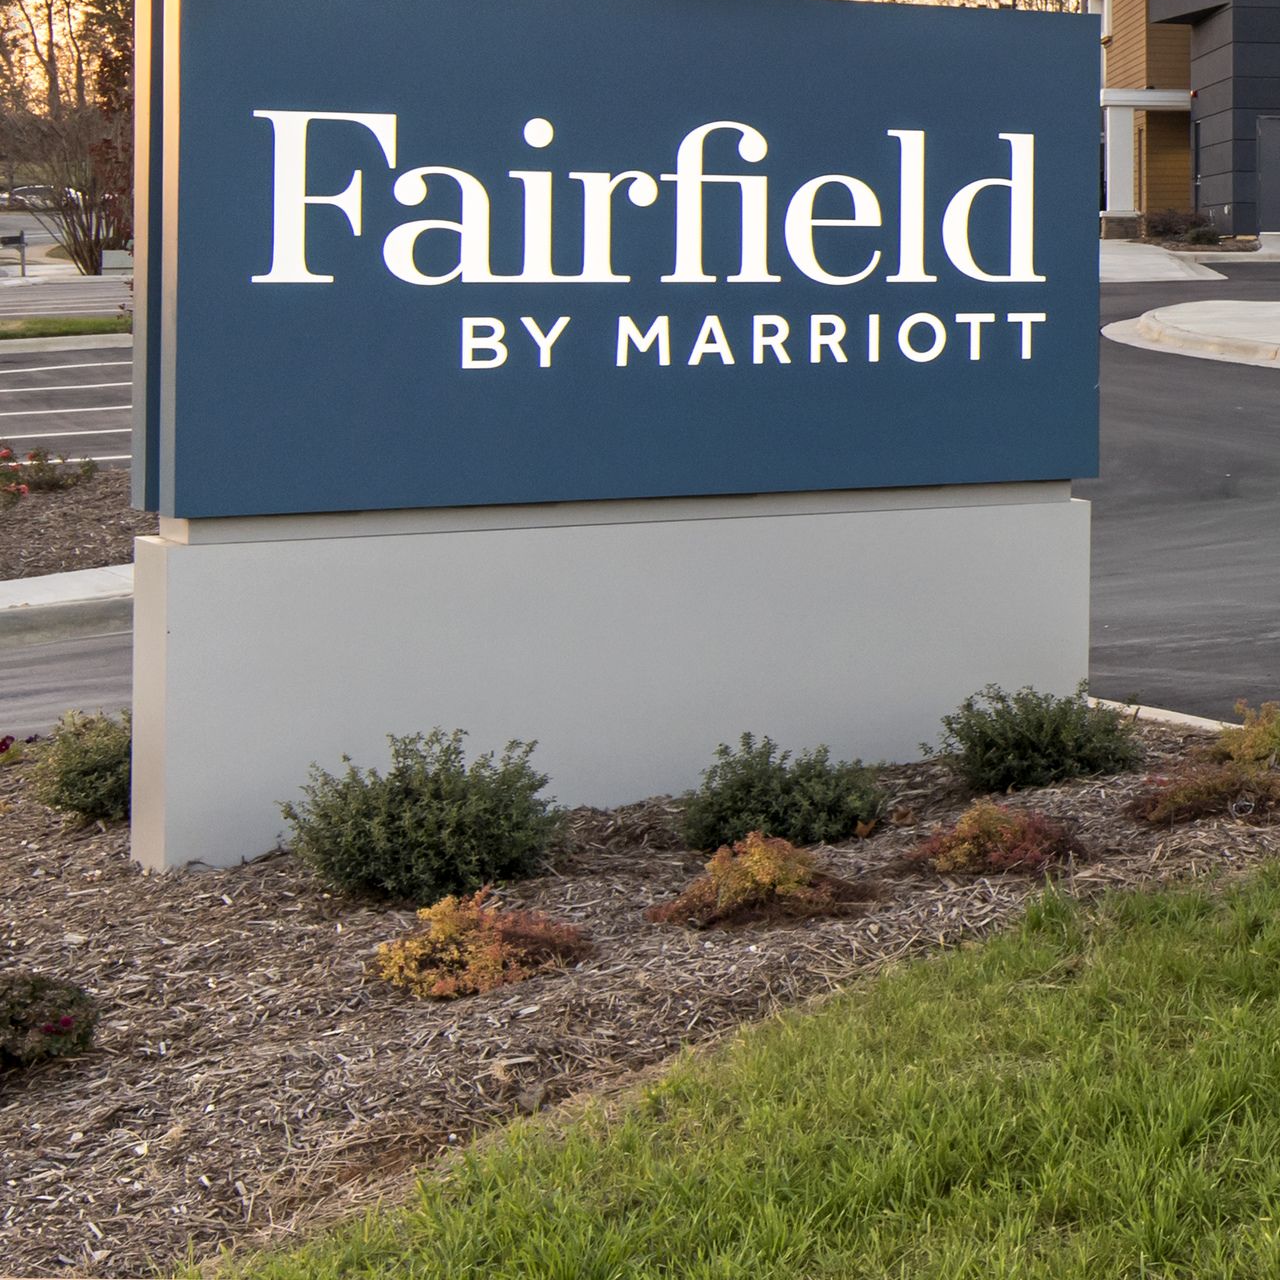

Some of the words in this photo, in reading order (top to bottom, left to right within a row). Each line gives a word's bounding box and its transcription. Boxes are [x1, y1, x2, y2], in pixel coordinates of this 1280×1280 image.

[251, 110, 1046, 286] Fairfield
[462, 317, 571, 369] BY
[616, 312, 1046, 367] MARRIOTT
